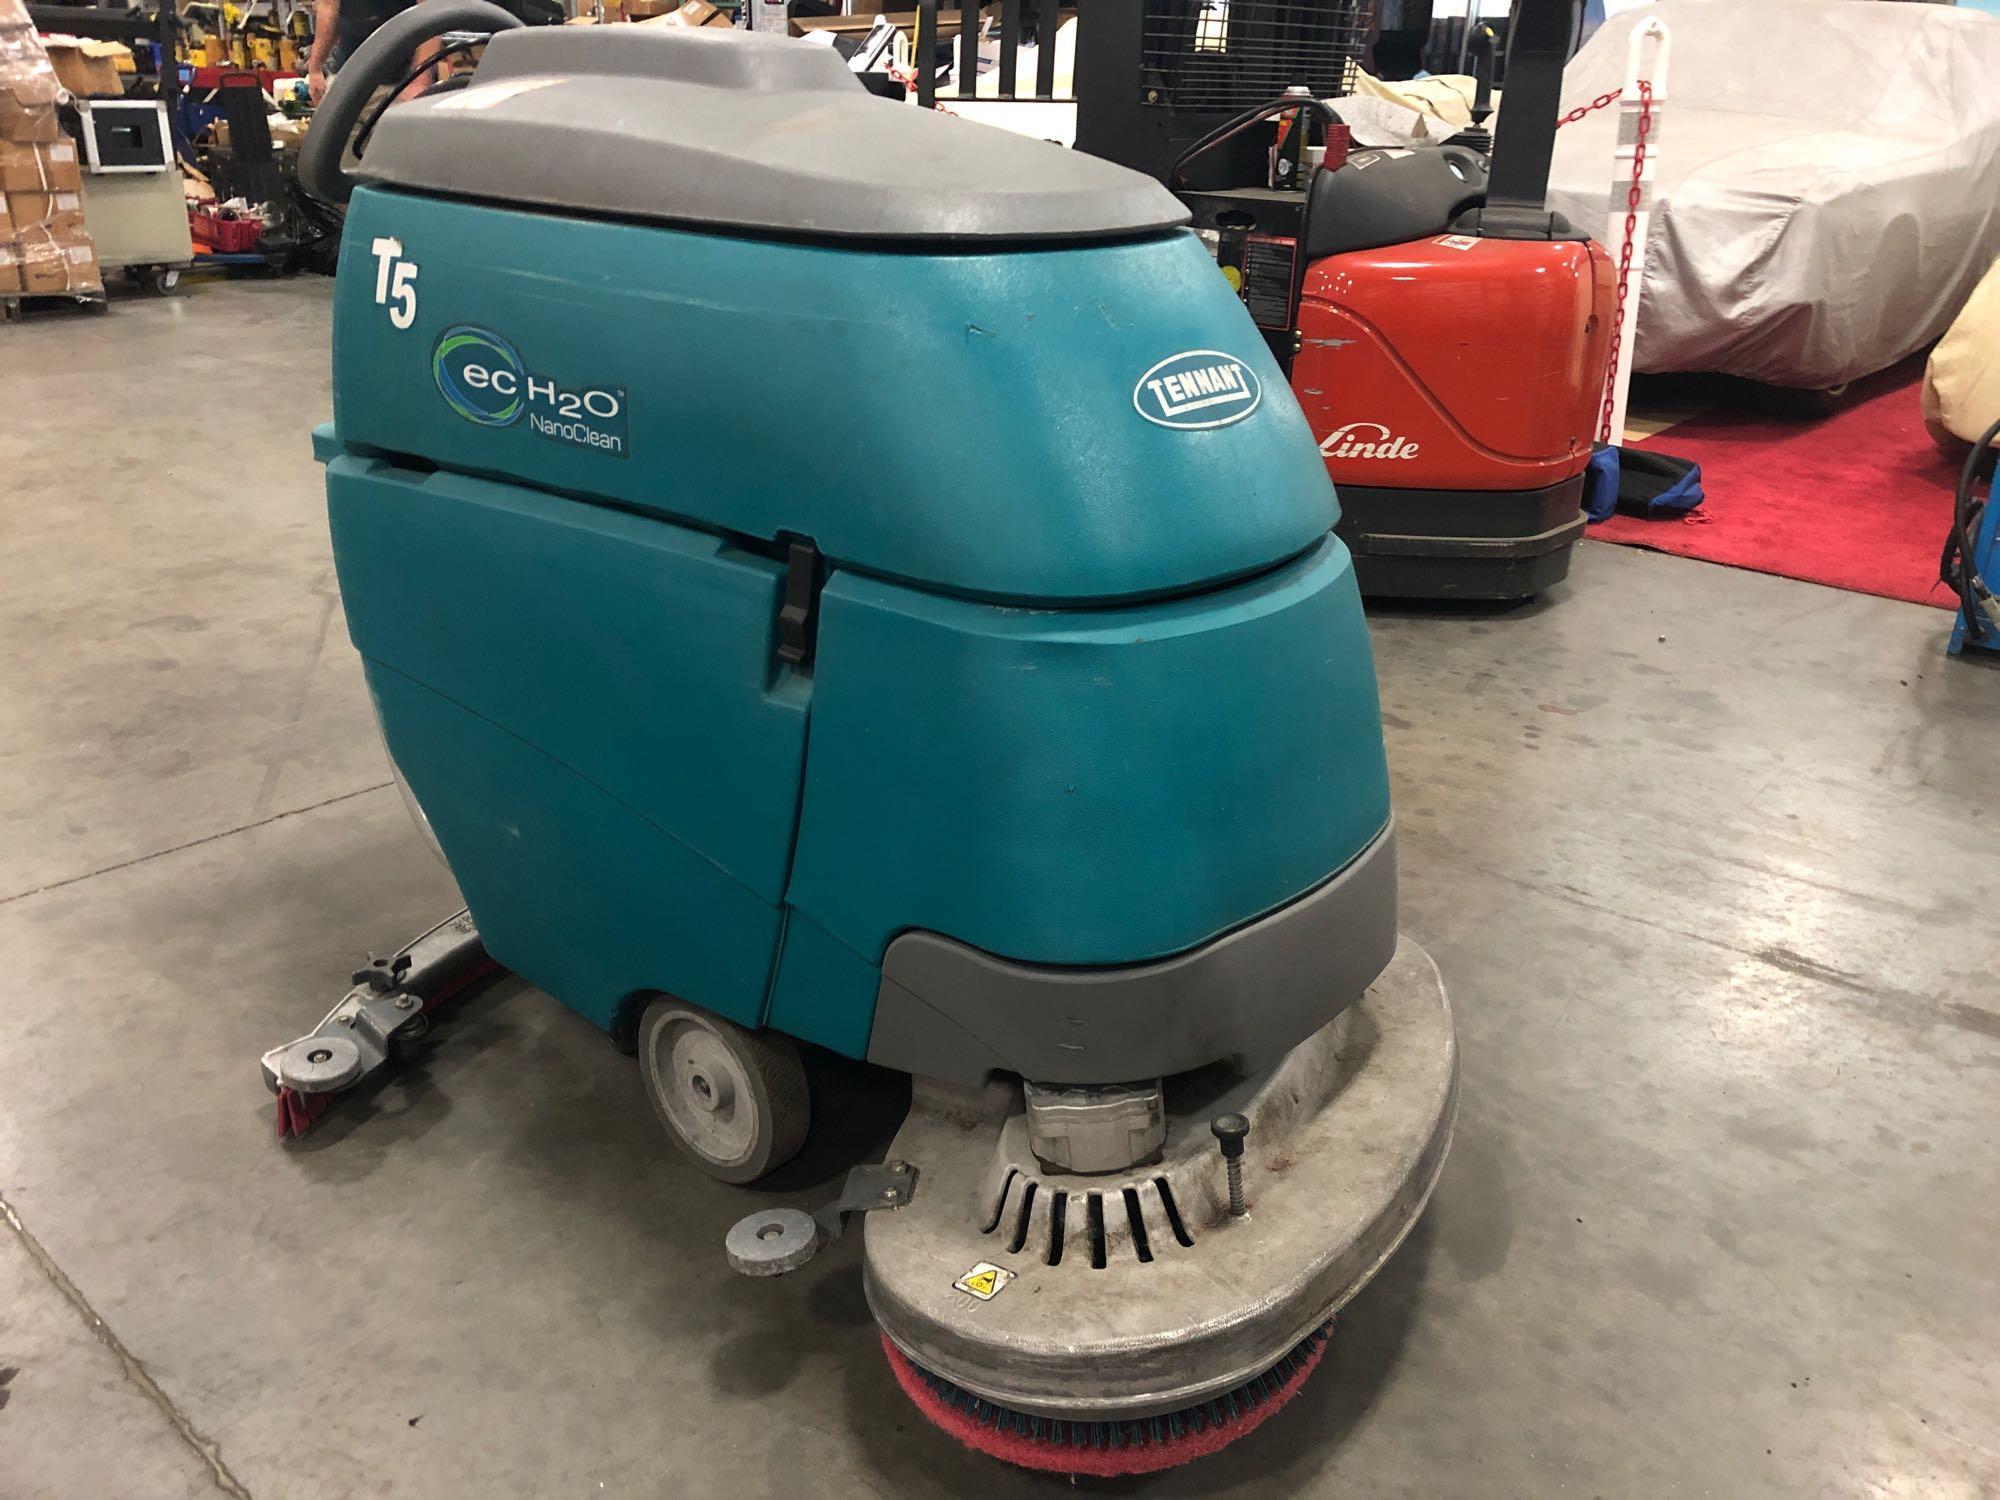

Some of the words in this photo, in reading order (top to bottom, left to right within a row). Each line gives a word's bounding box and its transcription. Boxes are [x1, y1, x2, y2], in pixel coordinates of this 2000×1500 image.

[371, 236, 418, 330] T5
[1147, 363, 1252, 417] TENNANT
[529, 412, 622, 452] NanoClean
[1319, 422, 1419, 460] Linde
